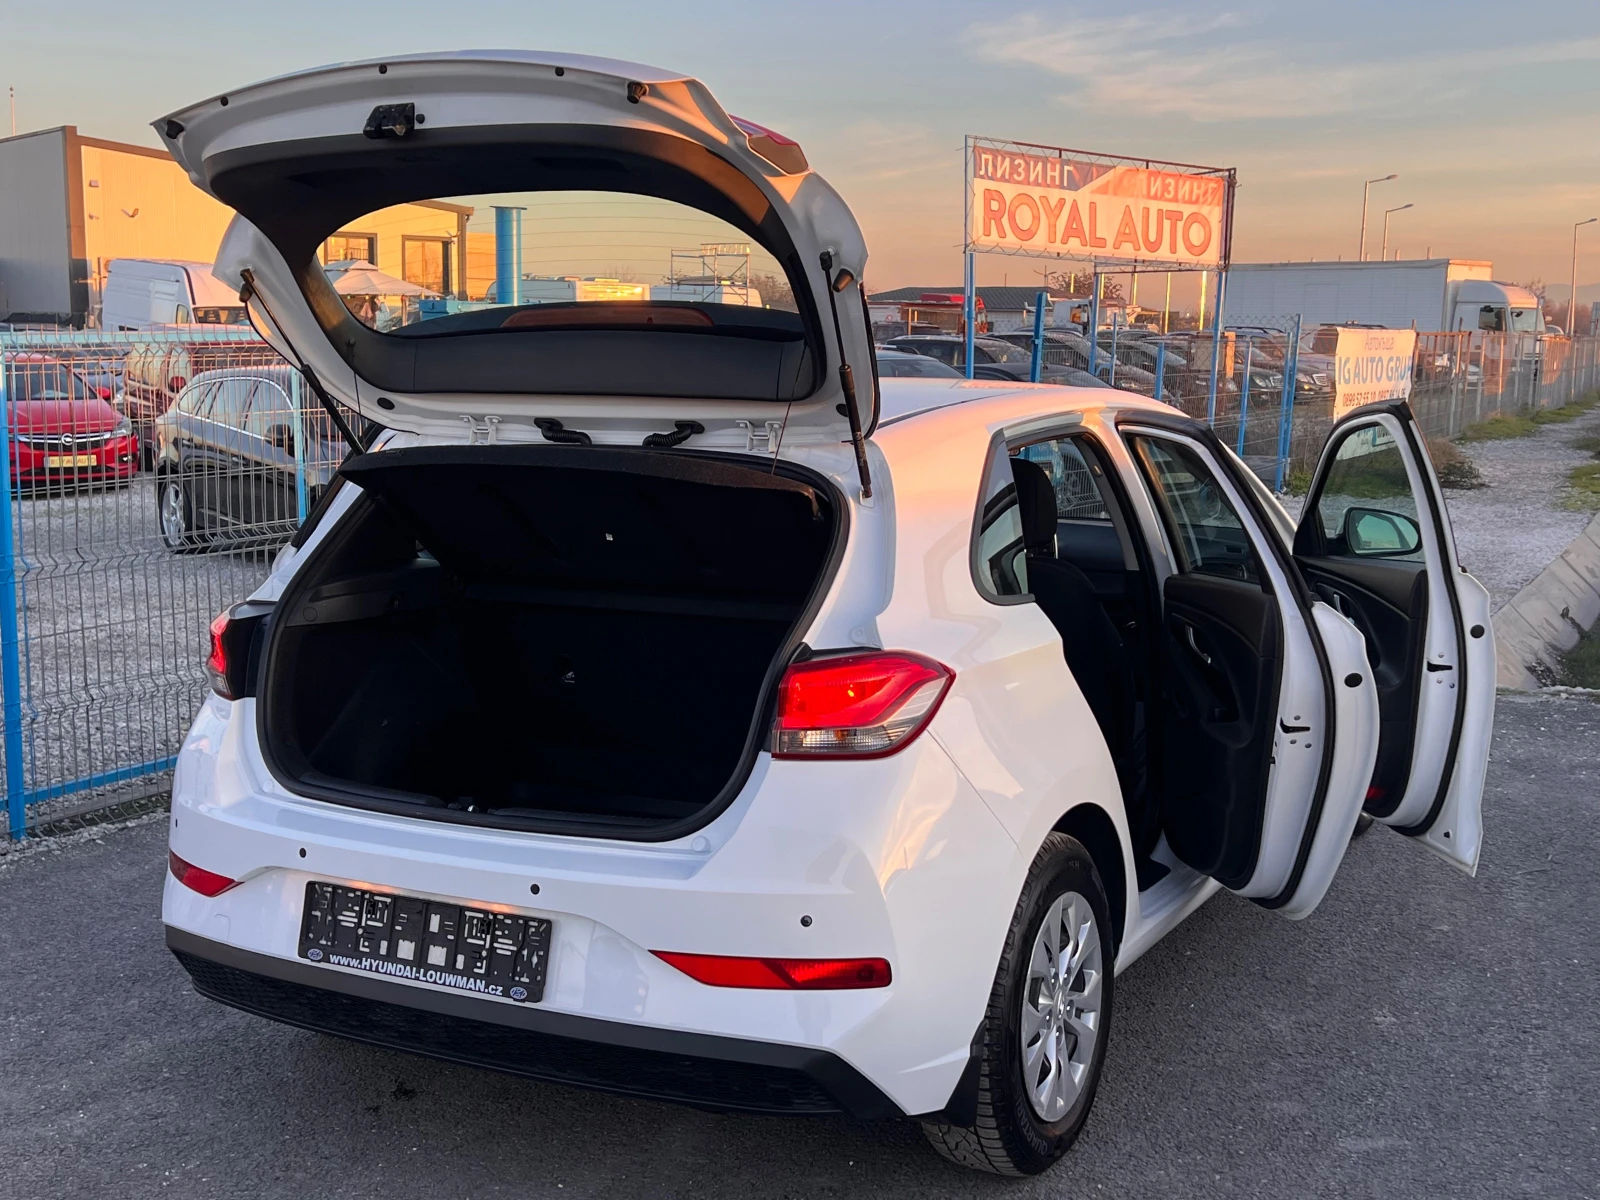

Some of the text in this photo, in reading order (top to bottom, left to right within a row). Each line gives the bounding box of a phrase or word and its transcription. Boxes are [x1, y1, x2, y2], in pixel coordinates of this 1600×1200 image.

[979, 153, 1074, 187] ЛИЗИНГ
[983, 188, 1212, 256] ROYAL AUTO
[1338, 356, 1351, 385] IG
[1353, 356, 1384, 384] AUTO
[329, 954, 504, 996] www.HYUNDAI-LOUWMAN.cz
